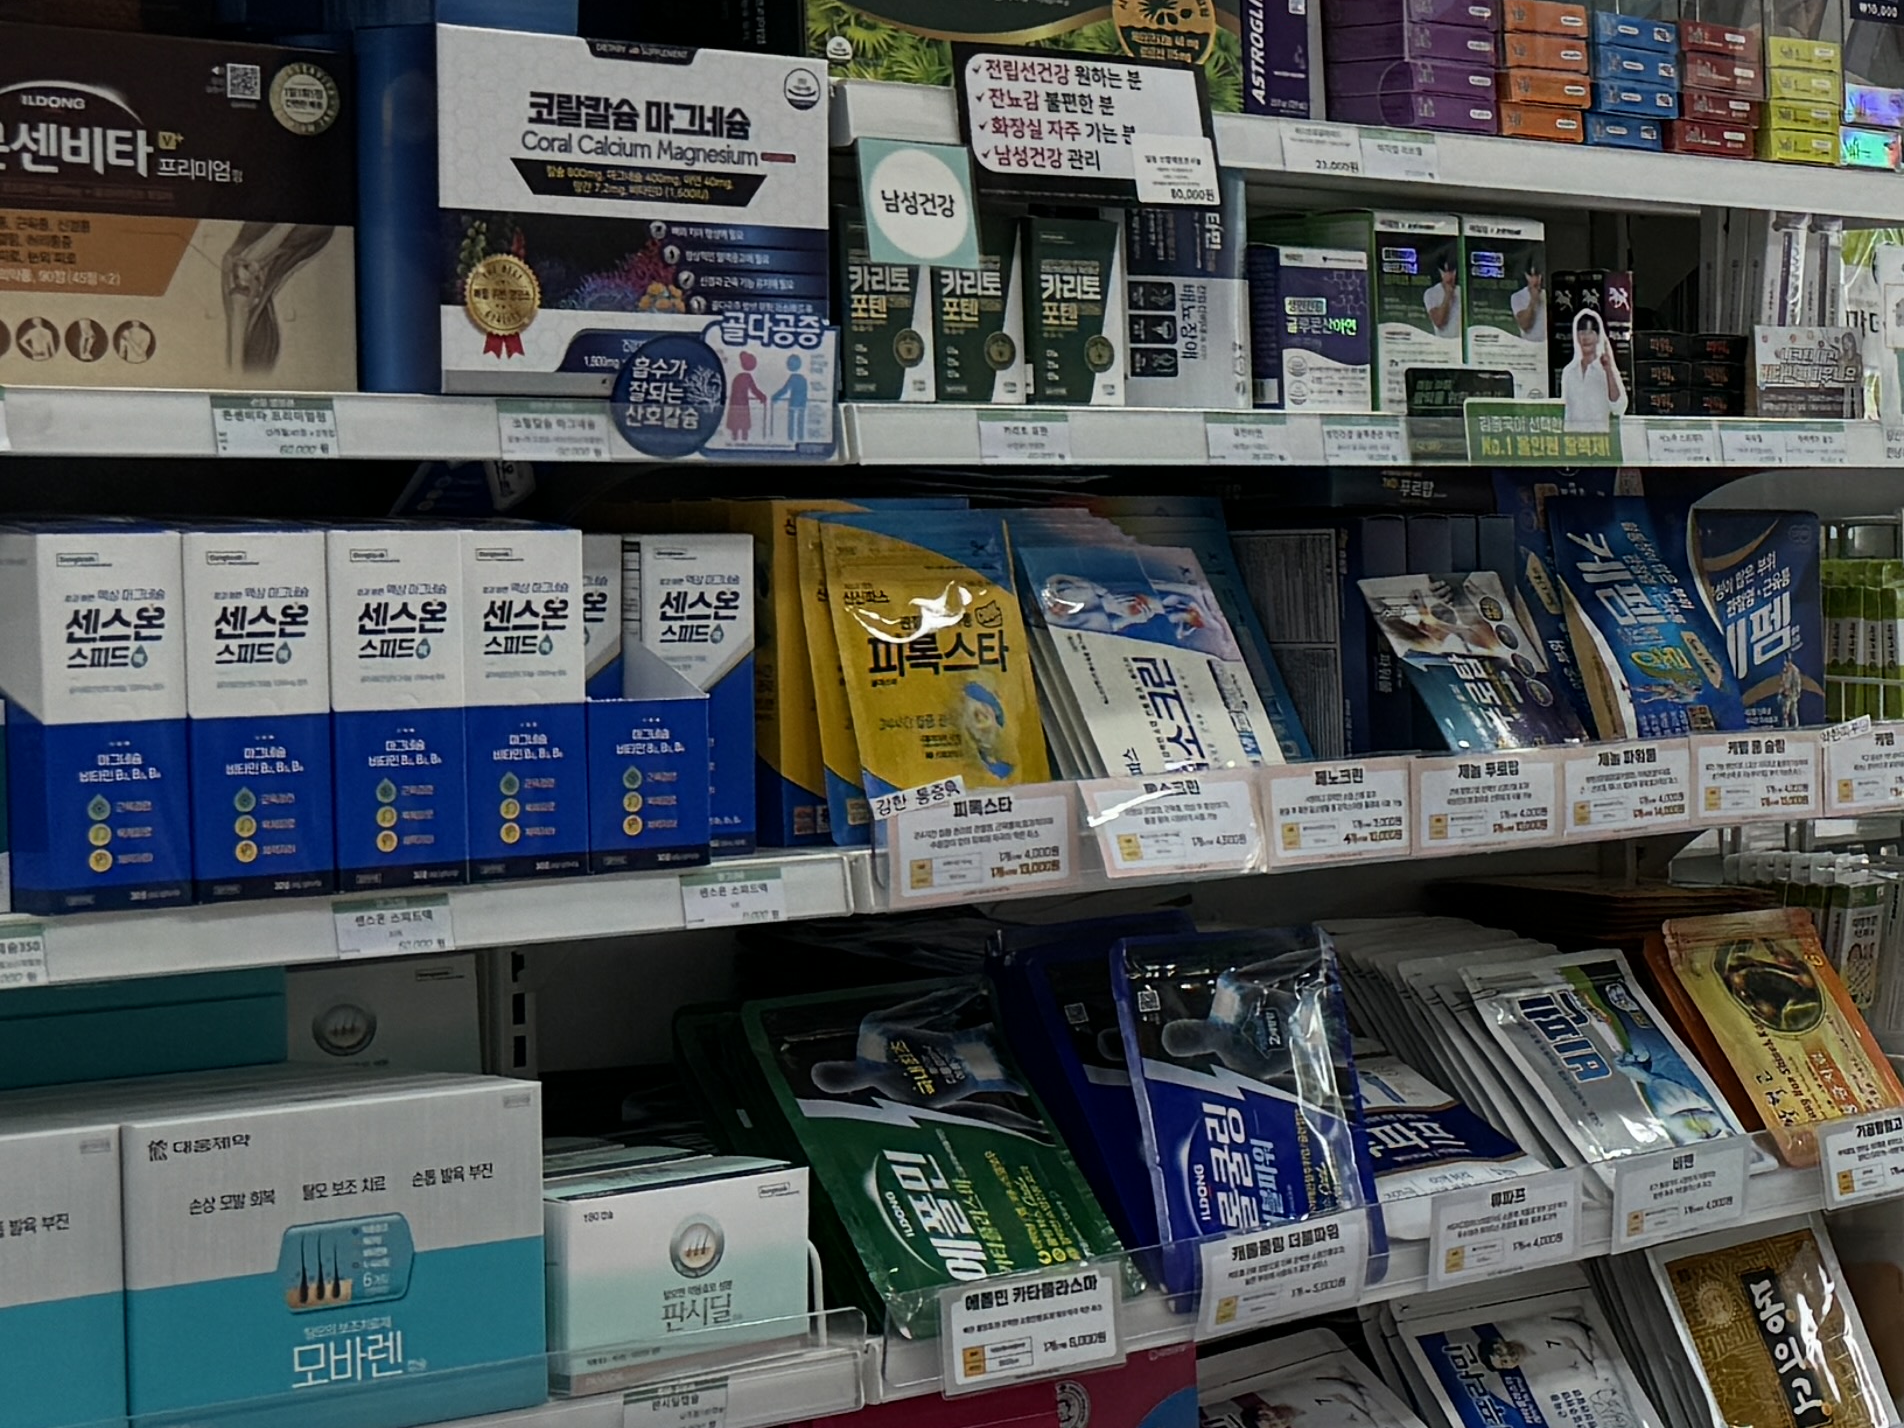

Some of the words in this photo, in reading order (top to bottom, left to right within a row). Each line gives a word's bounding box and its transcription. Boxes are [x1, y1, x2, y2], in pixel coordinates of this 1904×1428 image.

[985, 60, 1070, 84] 전립선건강
[1075, 61, 1123, 88] 원하는
[1126, 68, 1143, 90] 분
[21, 95, 85, 110] ILDONG
[528, 92, 639, 132] 코랄칼슘
[645, 103, 752, 139] 마그네슘
[988, 91, 1039, 112] 잔뇨감
[1044, 94, 1094, 115] 불편한
[1099, 96, 1114, 116] 분
[991, 118, 1045, 140] 화장실
[1048, 121, 1081, 139] 자주
[1086, 123, 1118, 144] 가는
[521, 131, 572, 155] Coral
[578, 135, 651, 160] Calcium
[657, 141, 758, 168] Magnesium
[994, 146, 1062, 169] 남성건강
[1067, 149, 1100, 170] 관리
[157, 159, 231, 183] 프리미엄
[881, 190, 954, 217] 남성건강
[848, 266, 911, 292] 카리토
[851, 295, 888, 319] 포텐
[720, 314, 825, 350] 골다공증
[631, 357, 687, 379] 흡수가
[629, 382, 683, 404] 잘되는
[625, 406, 699, 429] 산호칼슘
[66, 605, 166, 643] 센스온
[214, 602, 309, 640] 센스온
[67, 644, 130, 669] 스피드
[214, 641, 275, 666] 스피드
[868, 630, 1010, 677] 피록스타
[953, 796, 1012, 818] 피록스타
[172, 1133, 251, 1156] 대웅제약
[411, 1169, 438, 1188] 손톱
[441, 1166, 467, 1184] 발육
[469, 1162, 494, 1181] 부진
[189, 1198, 216, 1215] 손상
[220, 1191, 246, 1211] 모발
[250, 1188, 276, 1208] 회복
[302, 1182, 329, 1201] 탈모
[331, 1179, 358, 1198] 보조
[361, 1176, 386, 1195] 치료
[661, 1291, 732, 1333] 판시딜
[292, 1333, 404, 1388] 모바렌
